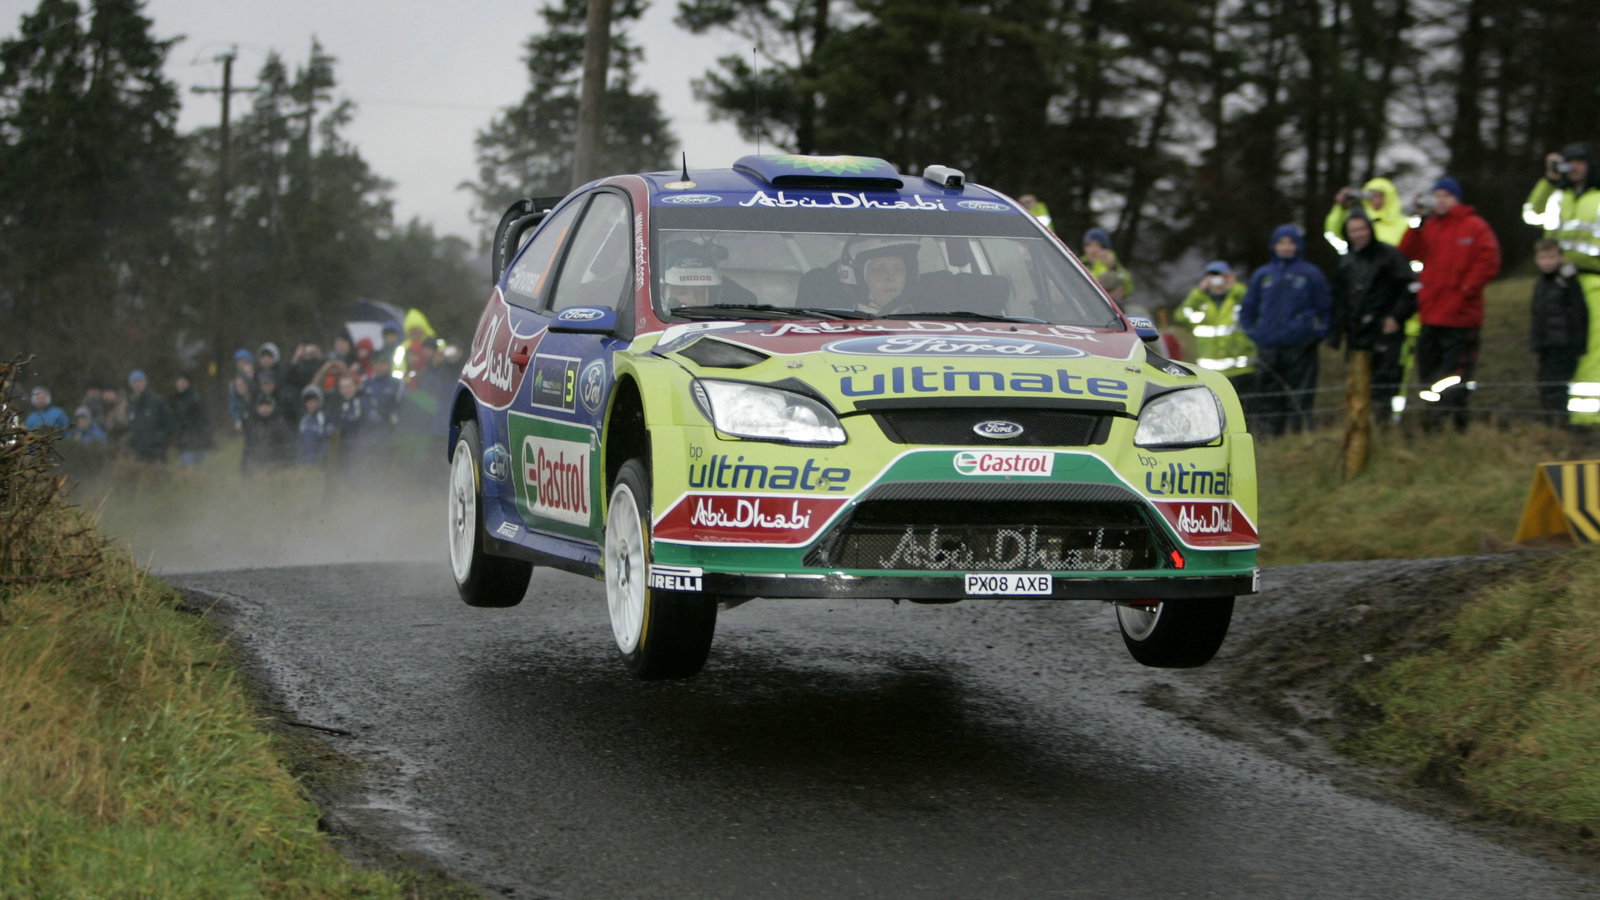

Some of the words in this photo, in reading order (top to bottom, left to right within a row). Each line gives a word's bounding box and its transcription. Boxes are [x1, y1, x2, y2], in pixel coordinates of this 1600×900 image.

[564, 311, 596, 319] Ford
[1130, 319, 1152, 328] Ford
[876, 335, 1041, 355] Ford
[831, 363, 868, 374] bp
[565, 369, 575, 402] 3
[584, 366, 603, 405] Ford
[840, 365, 1128, 399] ultimate
[985, 422, 1013, 433] Ford
[688, 443, 703, 460] bp
[979, 453, 1048, 473] Castrol
[1137, 453, 1158, 469] bp
[537, 446, 588, 514] Castrol
[688, 454, 851, 491] ultimate
[967, 576, 1009, 592] PX08
[1014, 576, 1050, 592] AXB
